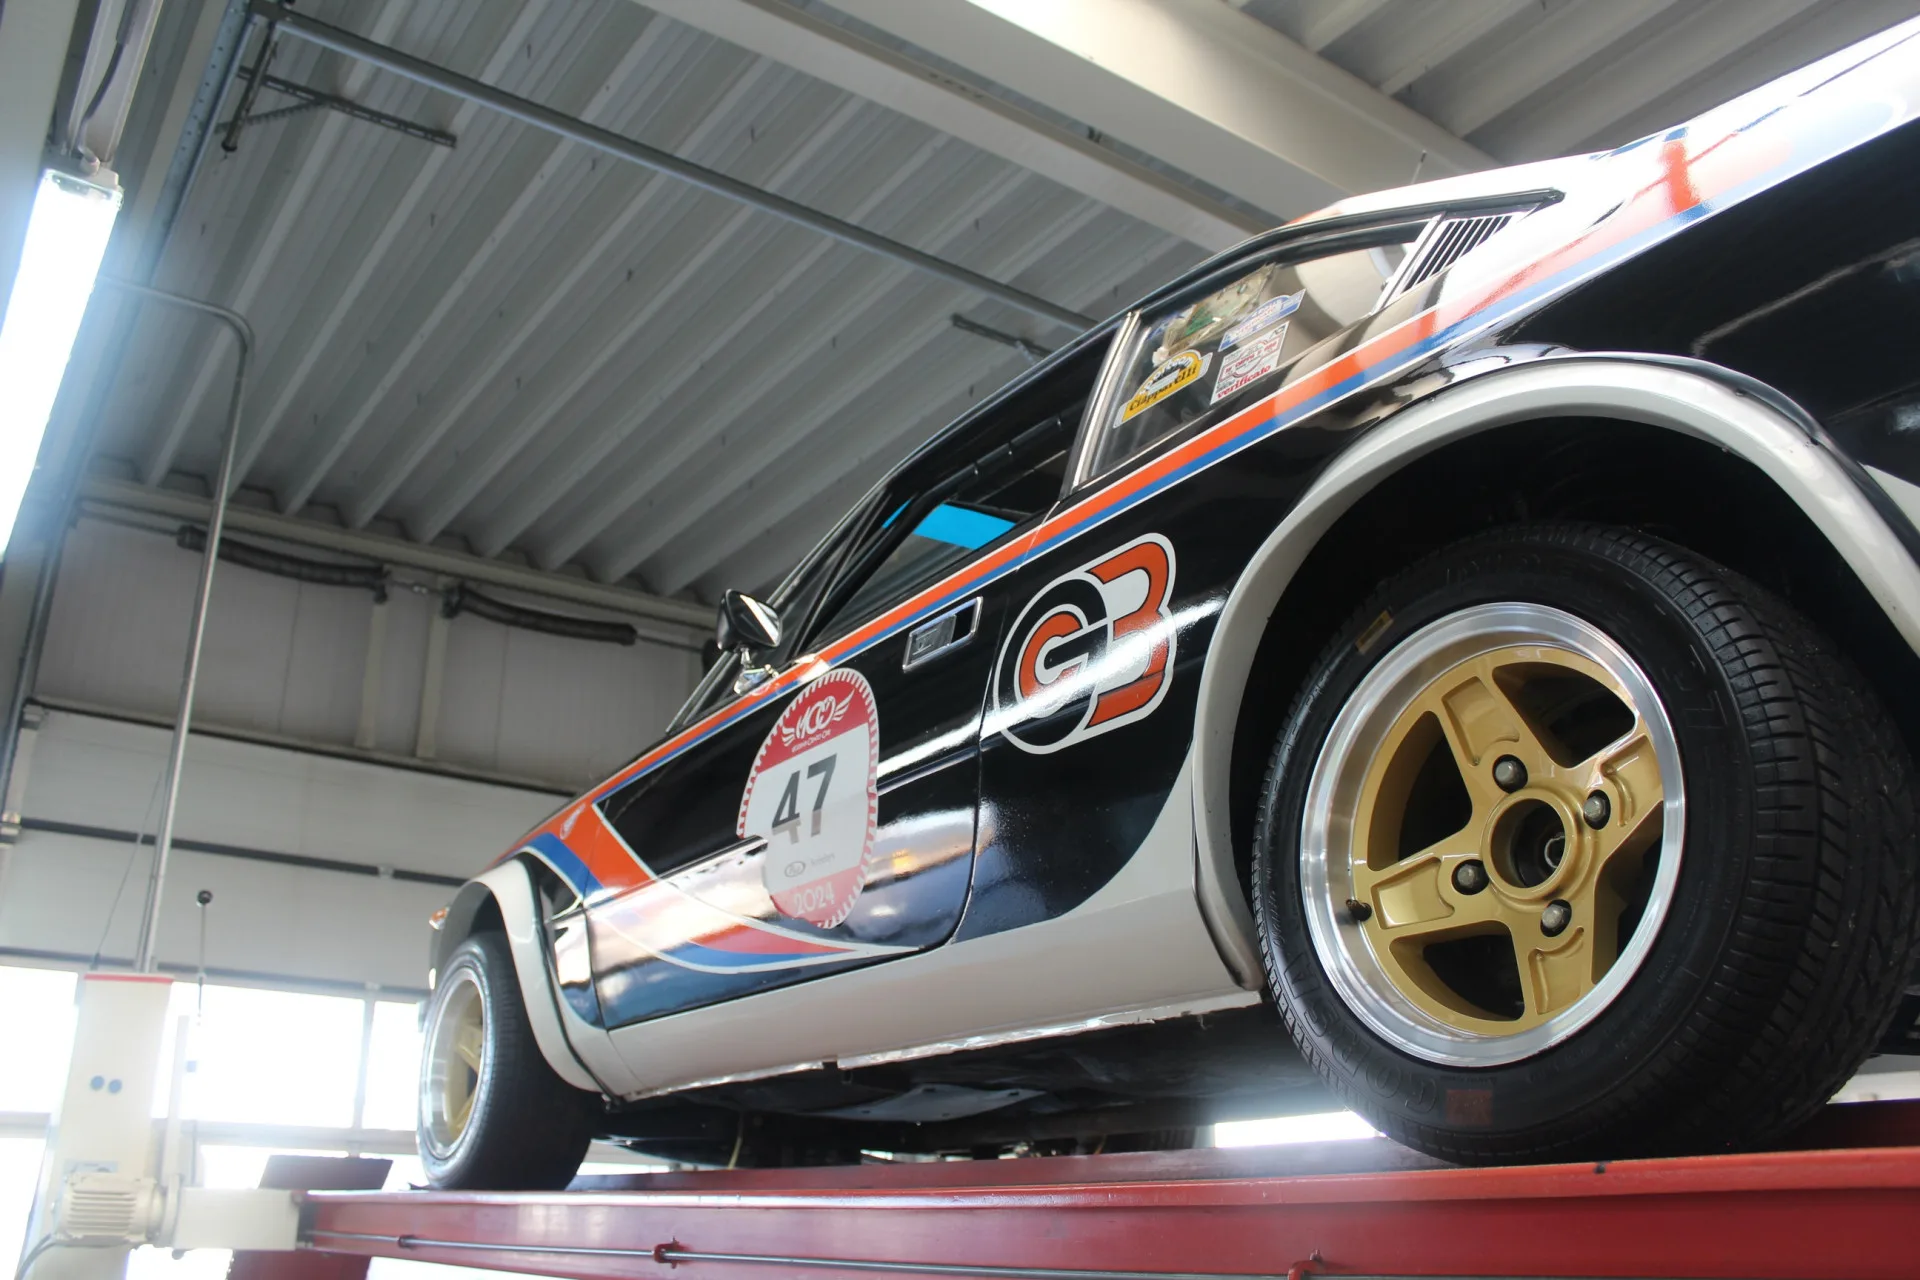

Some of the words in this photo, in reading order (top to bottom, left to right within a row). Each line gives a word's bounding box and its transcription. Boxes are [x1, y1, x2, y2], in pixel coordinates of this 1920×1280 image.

[1217, 365, 1271, 398] verificato
[771, 753, 837, 843] 47
[794, 886, 835, 916] 2024
